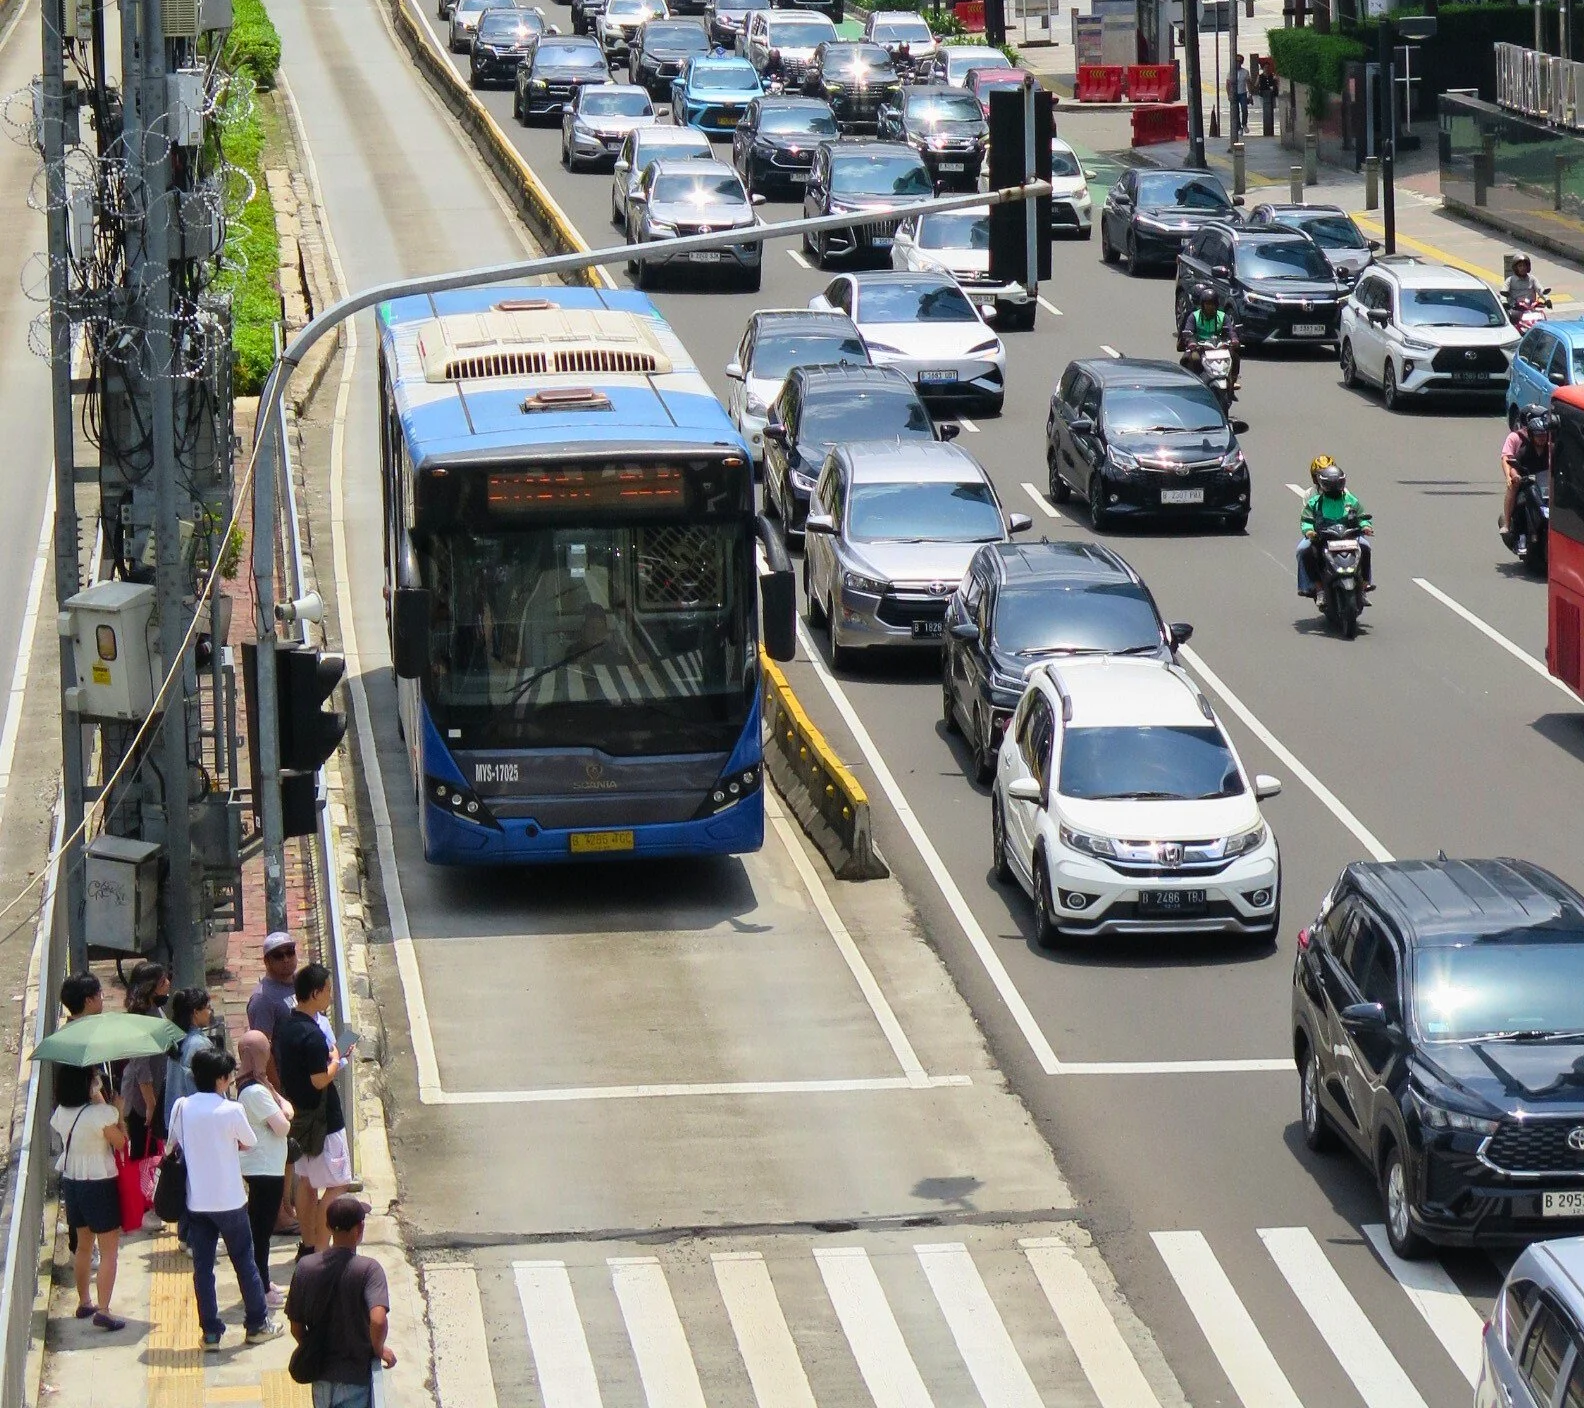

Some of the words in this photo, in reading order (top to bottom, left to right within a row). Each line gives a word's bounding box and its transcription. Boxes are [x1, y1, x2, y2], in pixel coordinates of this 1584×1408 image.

[914, 622, 919, 633] B
[925, 622, 942, 632] 1828
[475, 763, 519, 782] MYS-17025
[573, 779, 618, 790] SCANIA
[572, 835, 579, 845] B
[1142, 892, 1149, 904] B
[1156, 891, 1180, 904] 2486
[1187, 891, 1204, 903] TBJ
[1545, 1194, 1553, 1208] B
[1558, 1193, 1584, 1208] 295
